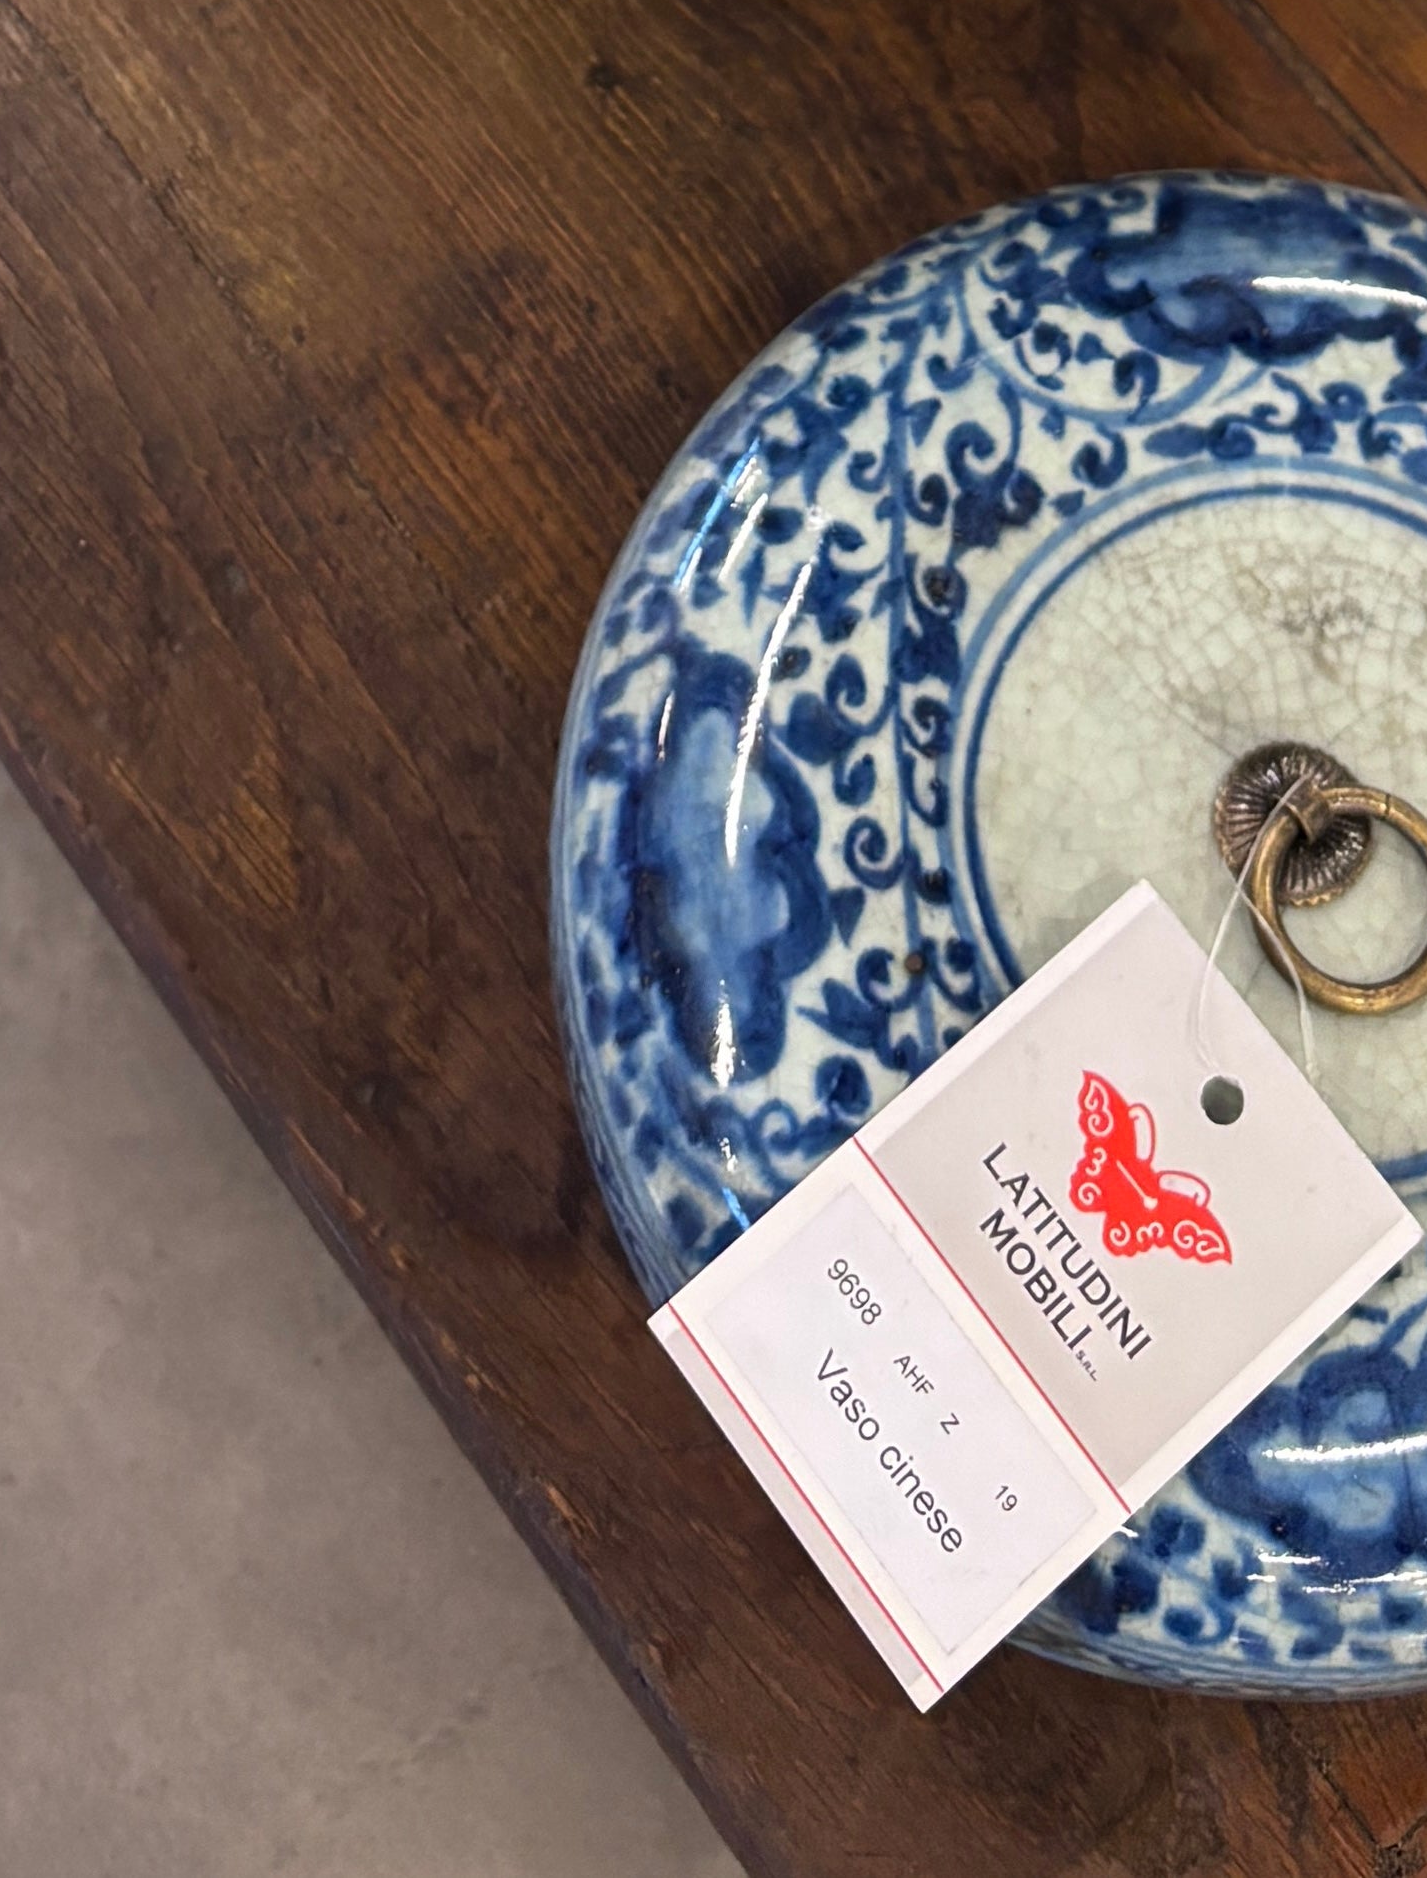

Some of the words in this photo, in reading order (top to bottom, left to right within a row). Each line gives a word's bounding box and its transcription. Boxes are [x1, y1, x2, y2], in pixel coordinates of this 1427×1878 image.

[978, 1206, 1094, 1352] MOBILI
[981, 1140, 1154, 1362] LATITUDINI
[816, 1345, 881, 1443] Vaso
[878, 1444, 964, 1555] cinese
[826, 1257, 883, 1327] 9698
[891, 1354, 936, 1396] AHF
[938, 1411, 962, 1437] Z
[993, 1484, 1019, 1513] 19
